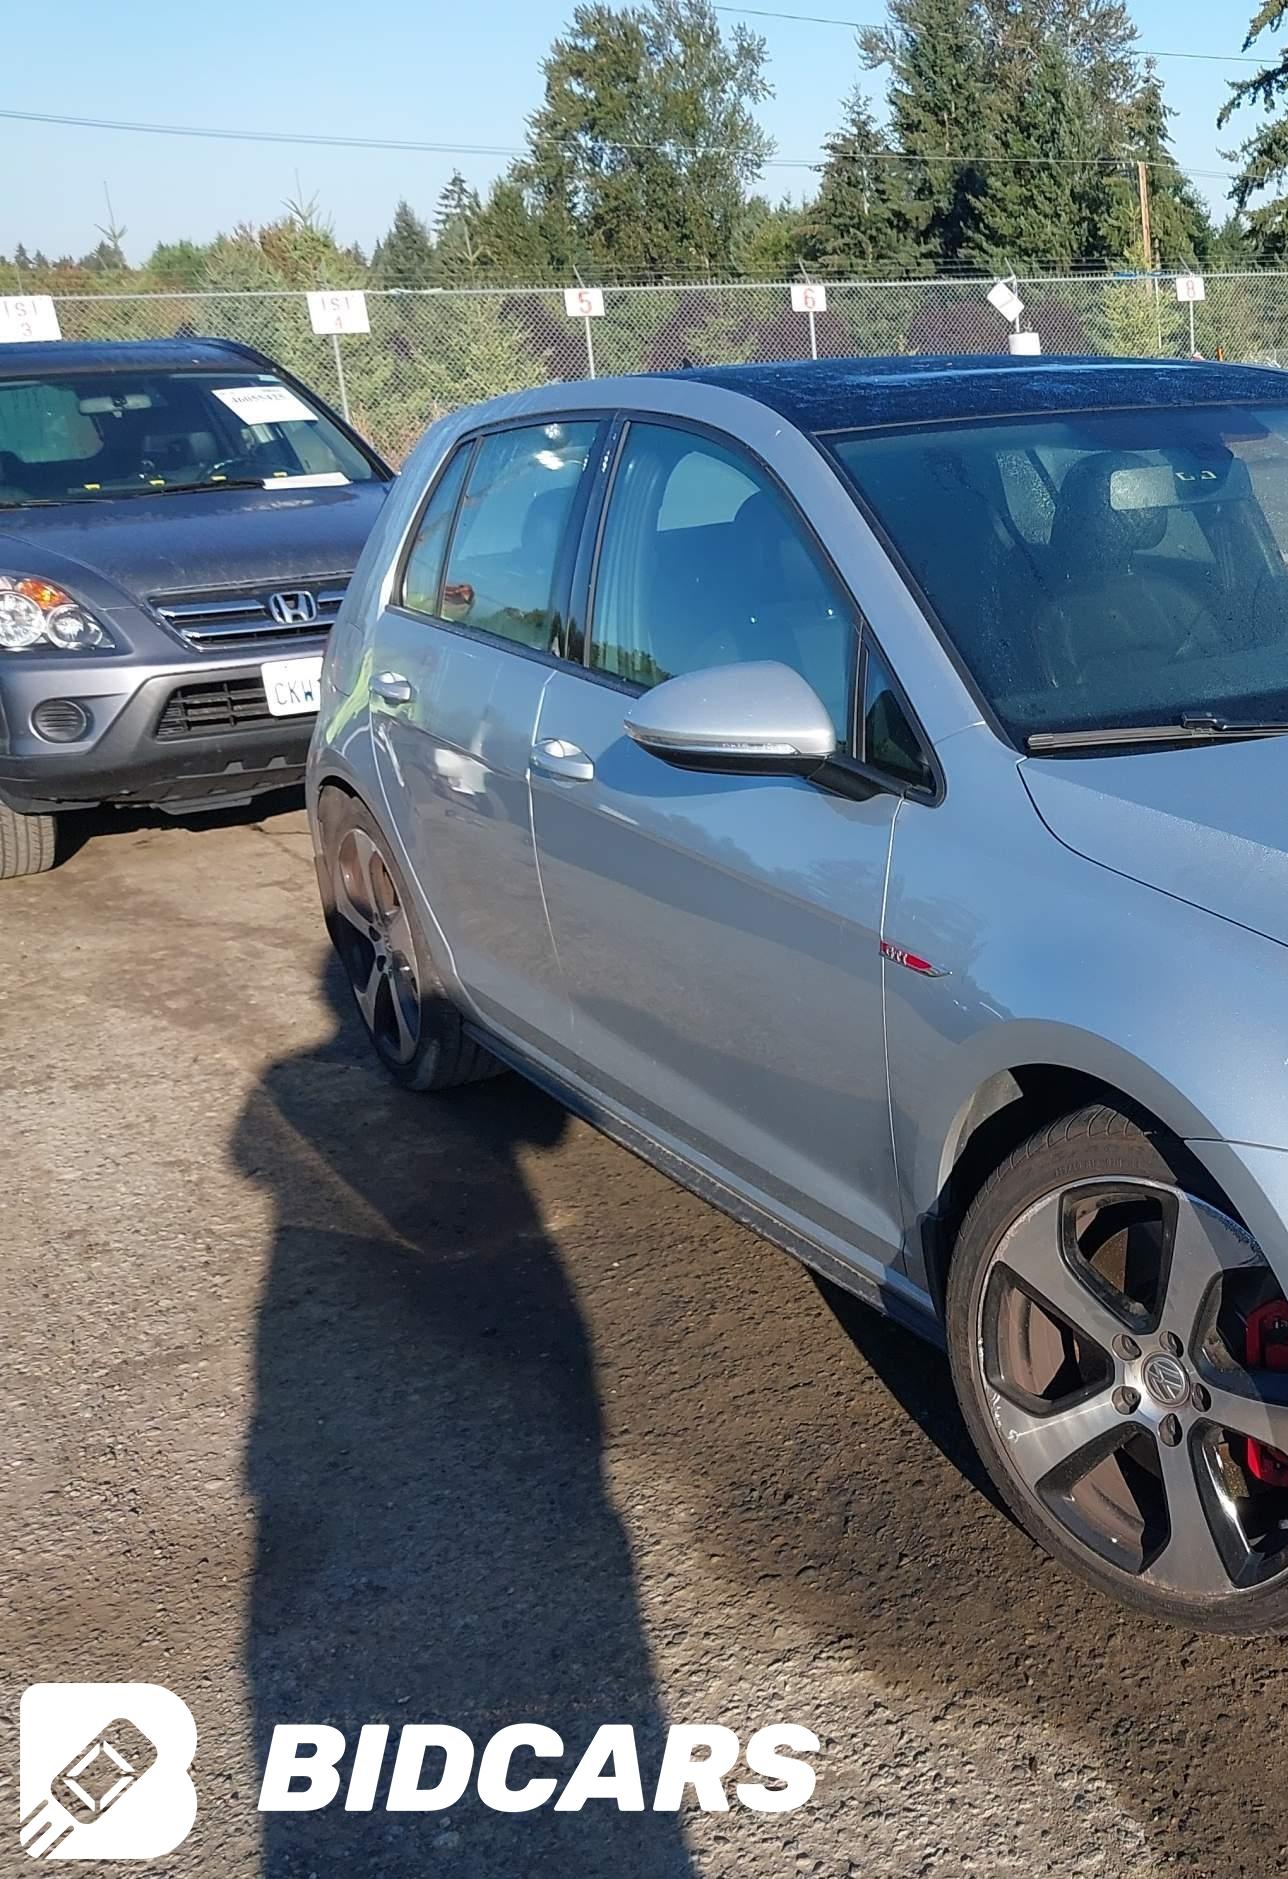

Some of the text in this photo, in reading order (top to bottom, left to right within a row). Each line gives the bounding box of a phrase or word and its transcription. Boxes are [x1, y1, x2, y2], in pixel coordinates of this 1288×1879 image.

[804, 287, 816, 310] 6
[1186, 279, 1196, 299] 8
[579, 289, 593, 314] 5
[20, 321, 33, 337] 3
[275, 678, 321, 705] CKW
